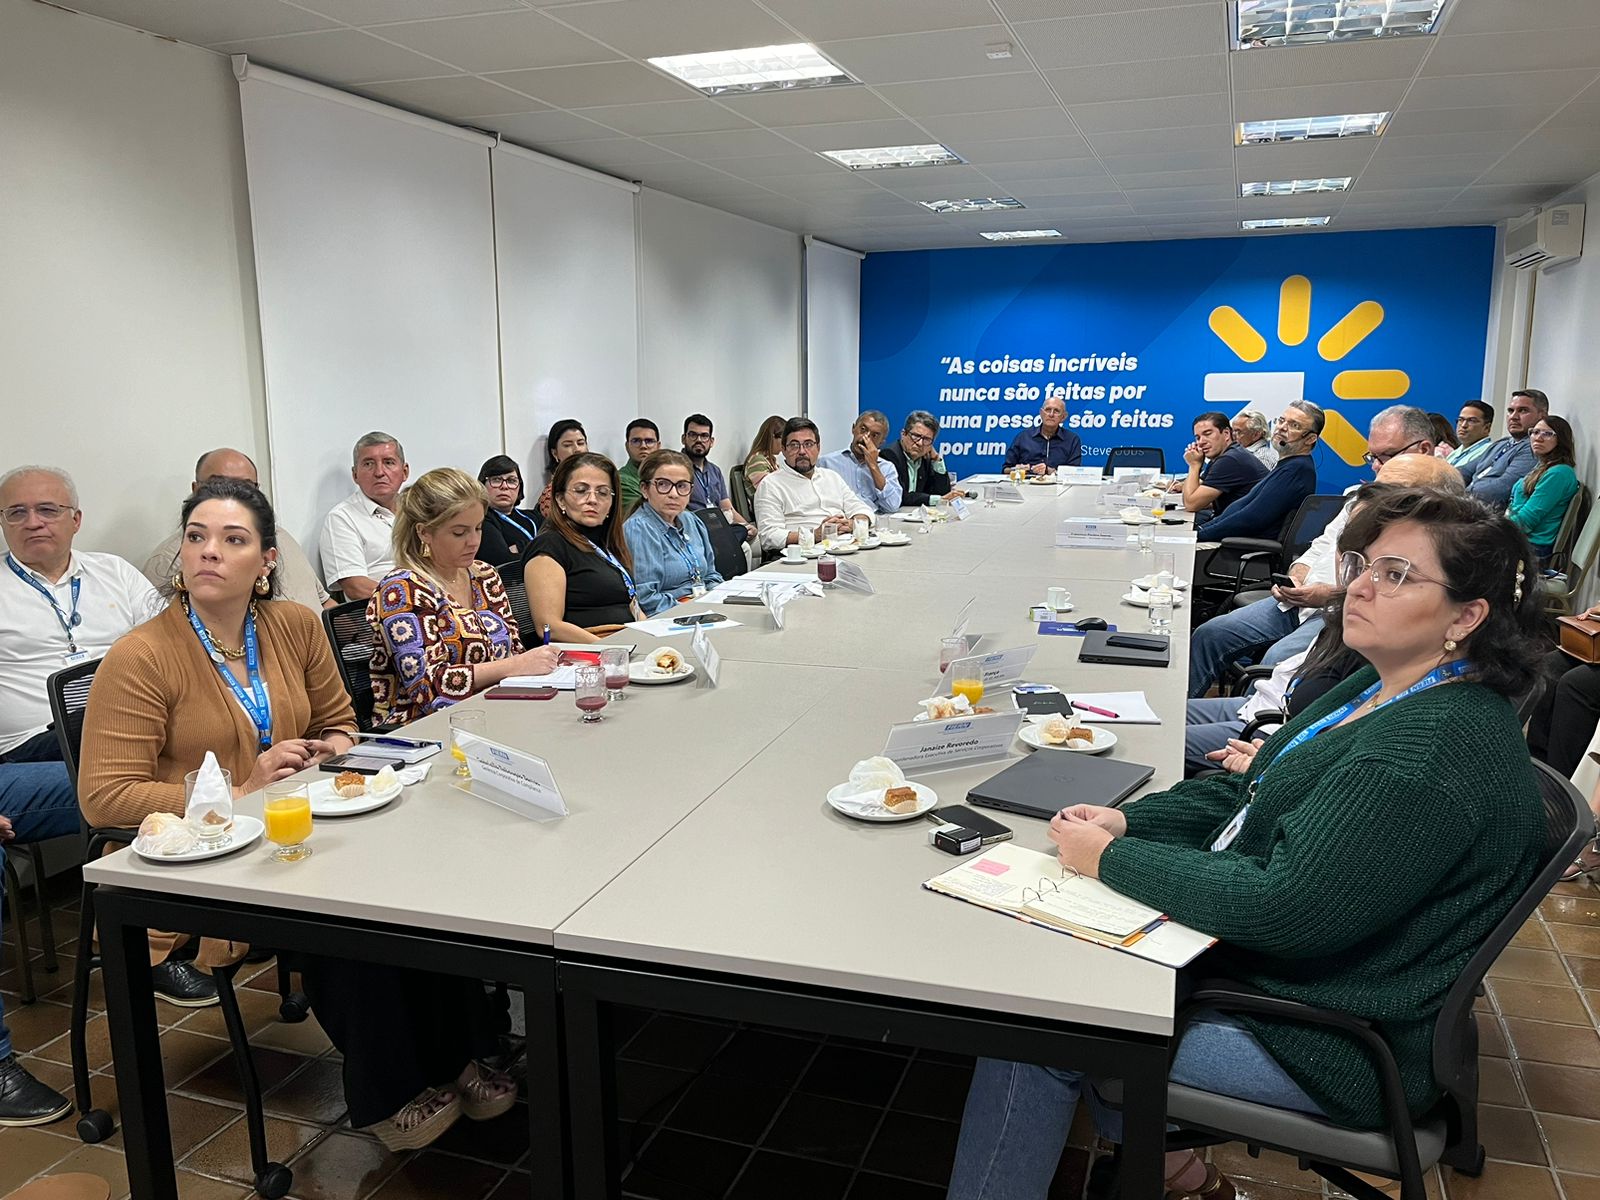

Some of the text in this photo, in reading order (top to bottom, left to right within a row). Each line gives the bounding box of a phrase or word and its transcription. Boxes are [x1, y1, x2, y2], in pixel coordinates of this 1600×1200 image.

[978, 354, 1045, 374] coisas
[1048, 351, 1138, 373] incríveis
[939, 381, 1147, 404] nunca são feitas por
[939, 414, 982, 429] uma
[1069, 410, 1106, 428] são
[1111, 408, 1174, 428] feitas
[939, 441, 1007, 458] por um
[1080, 444, 1112, 456] Steve
[920, 739, 979, 754] Janaize Revoredo
